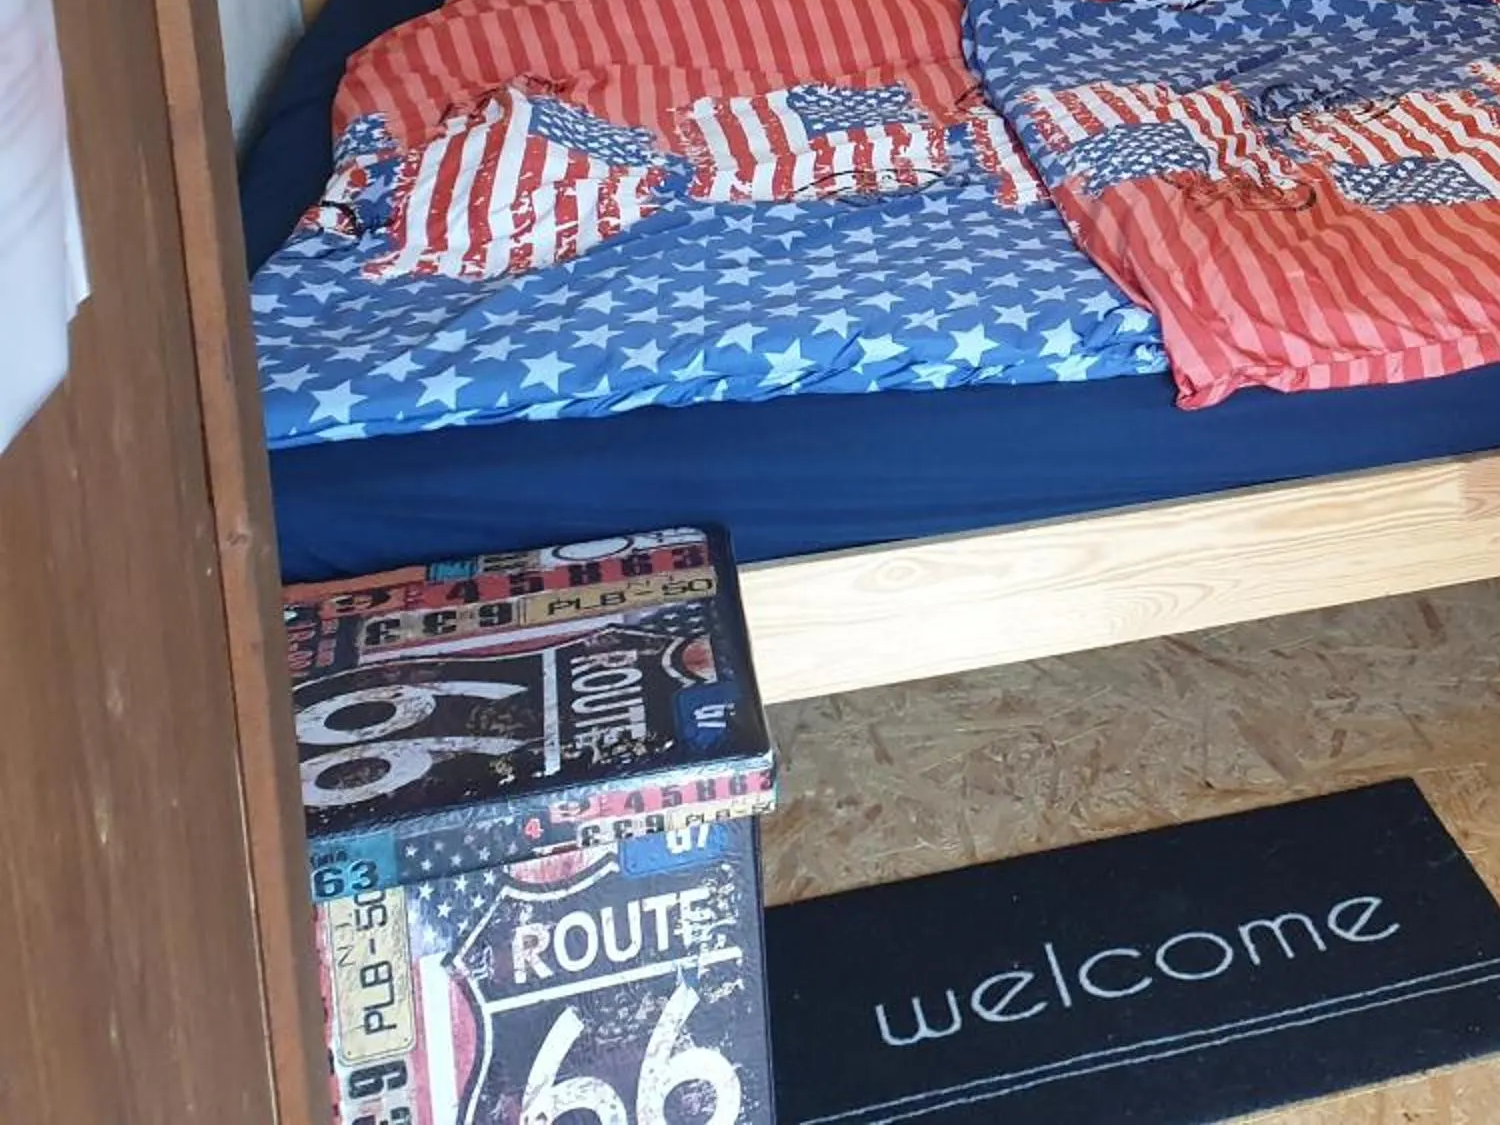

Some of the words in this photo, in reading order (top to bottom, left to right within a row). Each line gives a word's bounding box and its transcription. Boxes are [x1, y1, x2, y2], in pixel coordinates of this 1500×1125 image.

[296, 681, 528, 807] 66
[571, 649, 647, 749] ROUTE
[313, 861, 378, 897] 63
[512, 885, 712, 985] ROUTE
[875, 896, 1399, 1046] welcome
[518, 979, 743, 1125] 66
